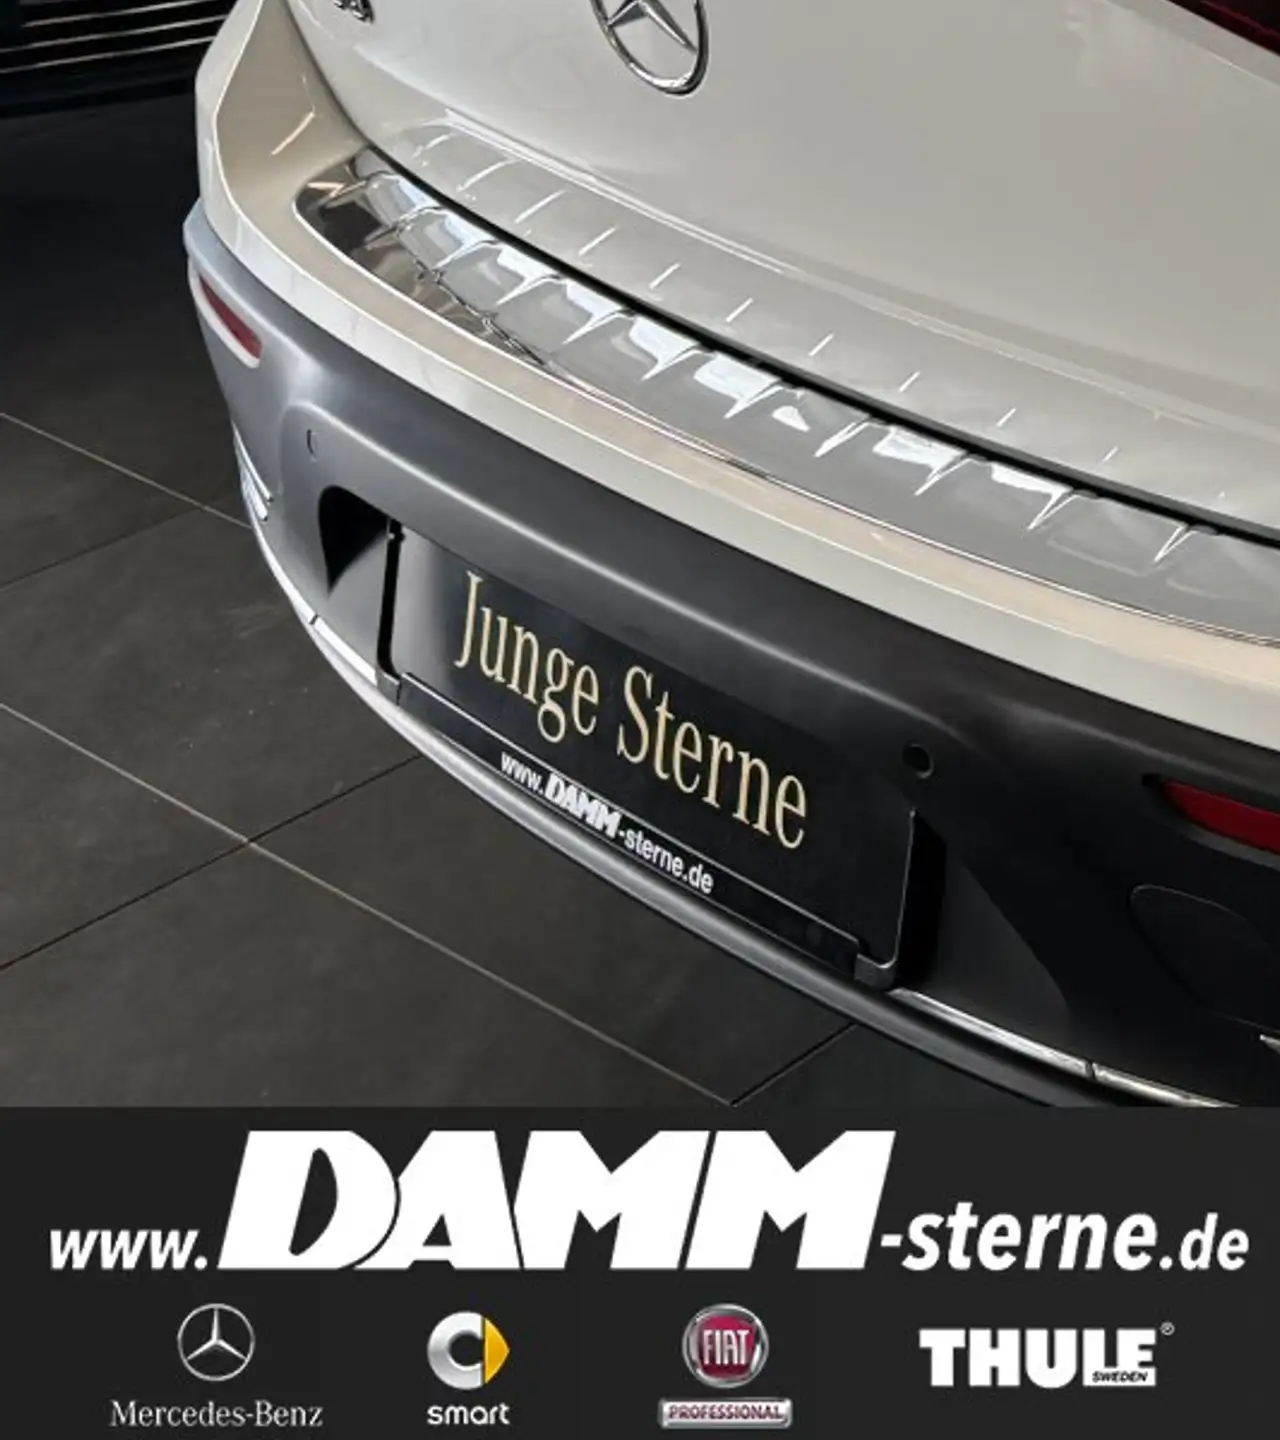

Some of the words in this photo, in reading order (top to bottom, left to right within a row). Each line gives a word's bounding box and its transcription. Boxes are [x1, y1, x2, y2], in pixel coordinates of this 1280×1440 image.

[454, 570, 600, 743] Junge
[616, 665, 807, 849] Sterne
[500, 750, 714, 895] www.DAMM-sterne.de
